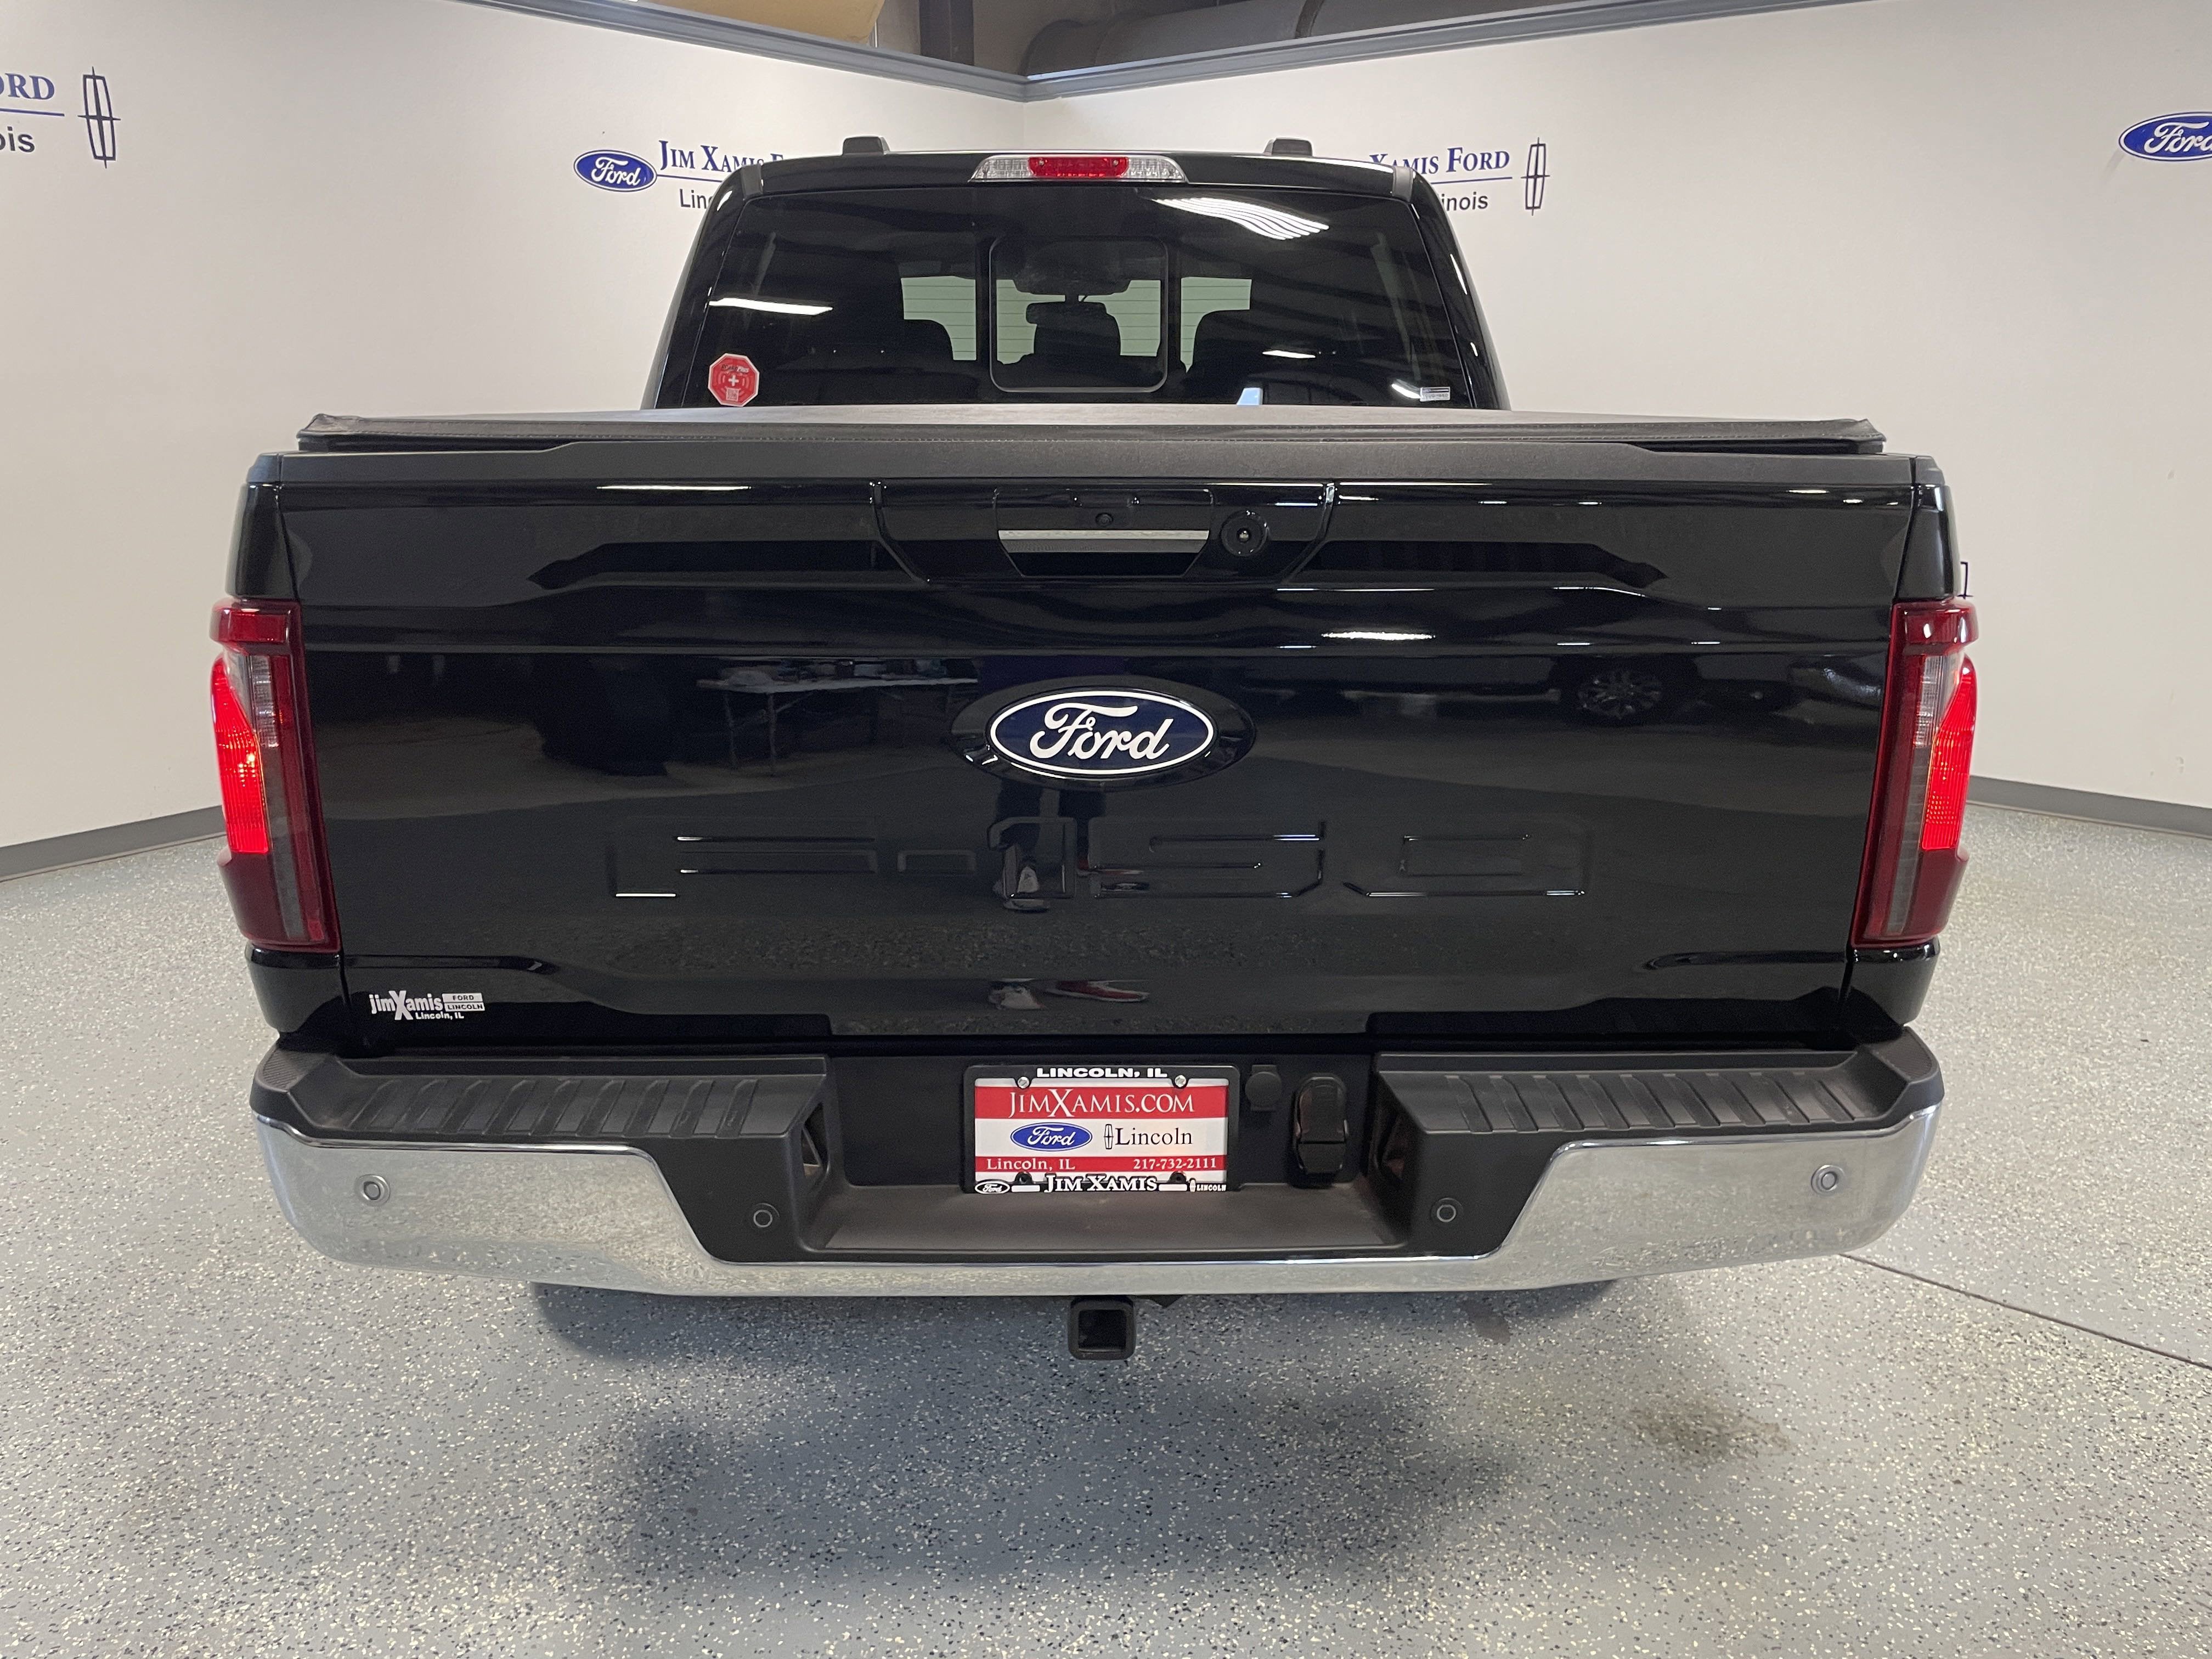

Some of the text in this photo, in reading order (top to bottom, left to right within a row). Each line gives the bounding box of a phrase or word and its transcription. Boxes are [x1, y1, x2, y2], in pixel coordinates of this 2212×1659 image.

[591, 157, 641, 187] Ford
[1030, 703, 1173, 759] Ford
[1037, 1068, 1167, 1078] LINCOLN, IL
[1027, 1126, 1193, 1146] Ford Lincoln
[986, 1158, 1216, 1171] Lincoln, IL 217-732-2111
